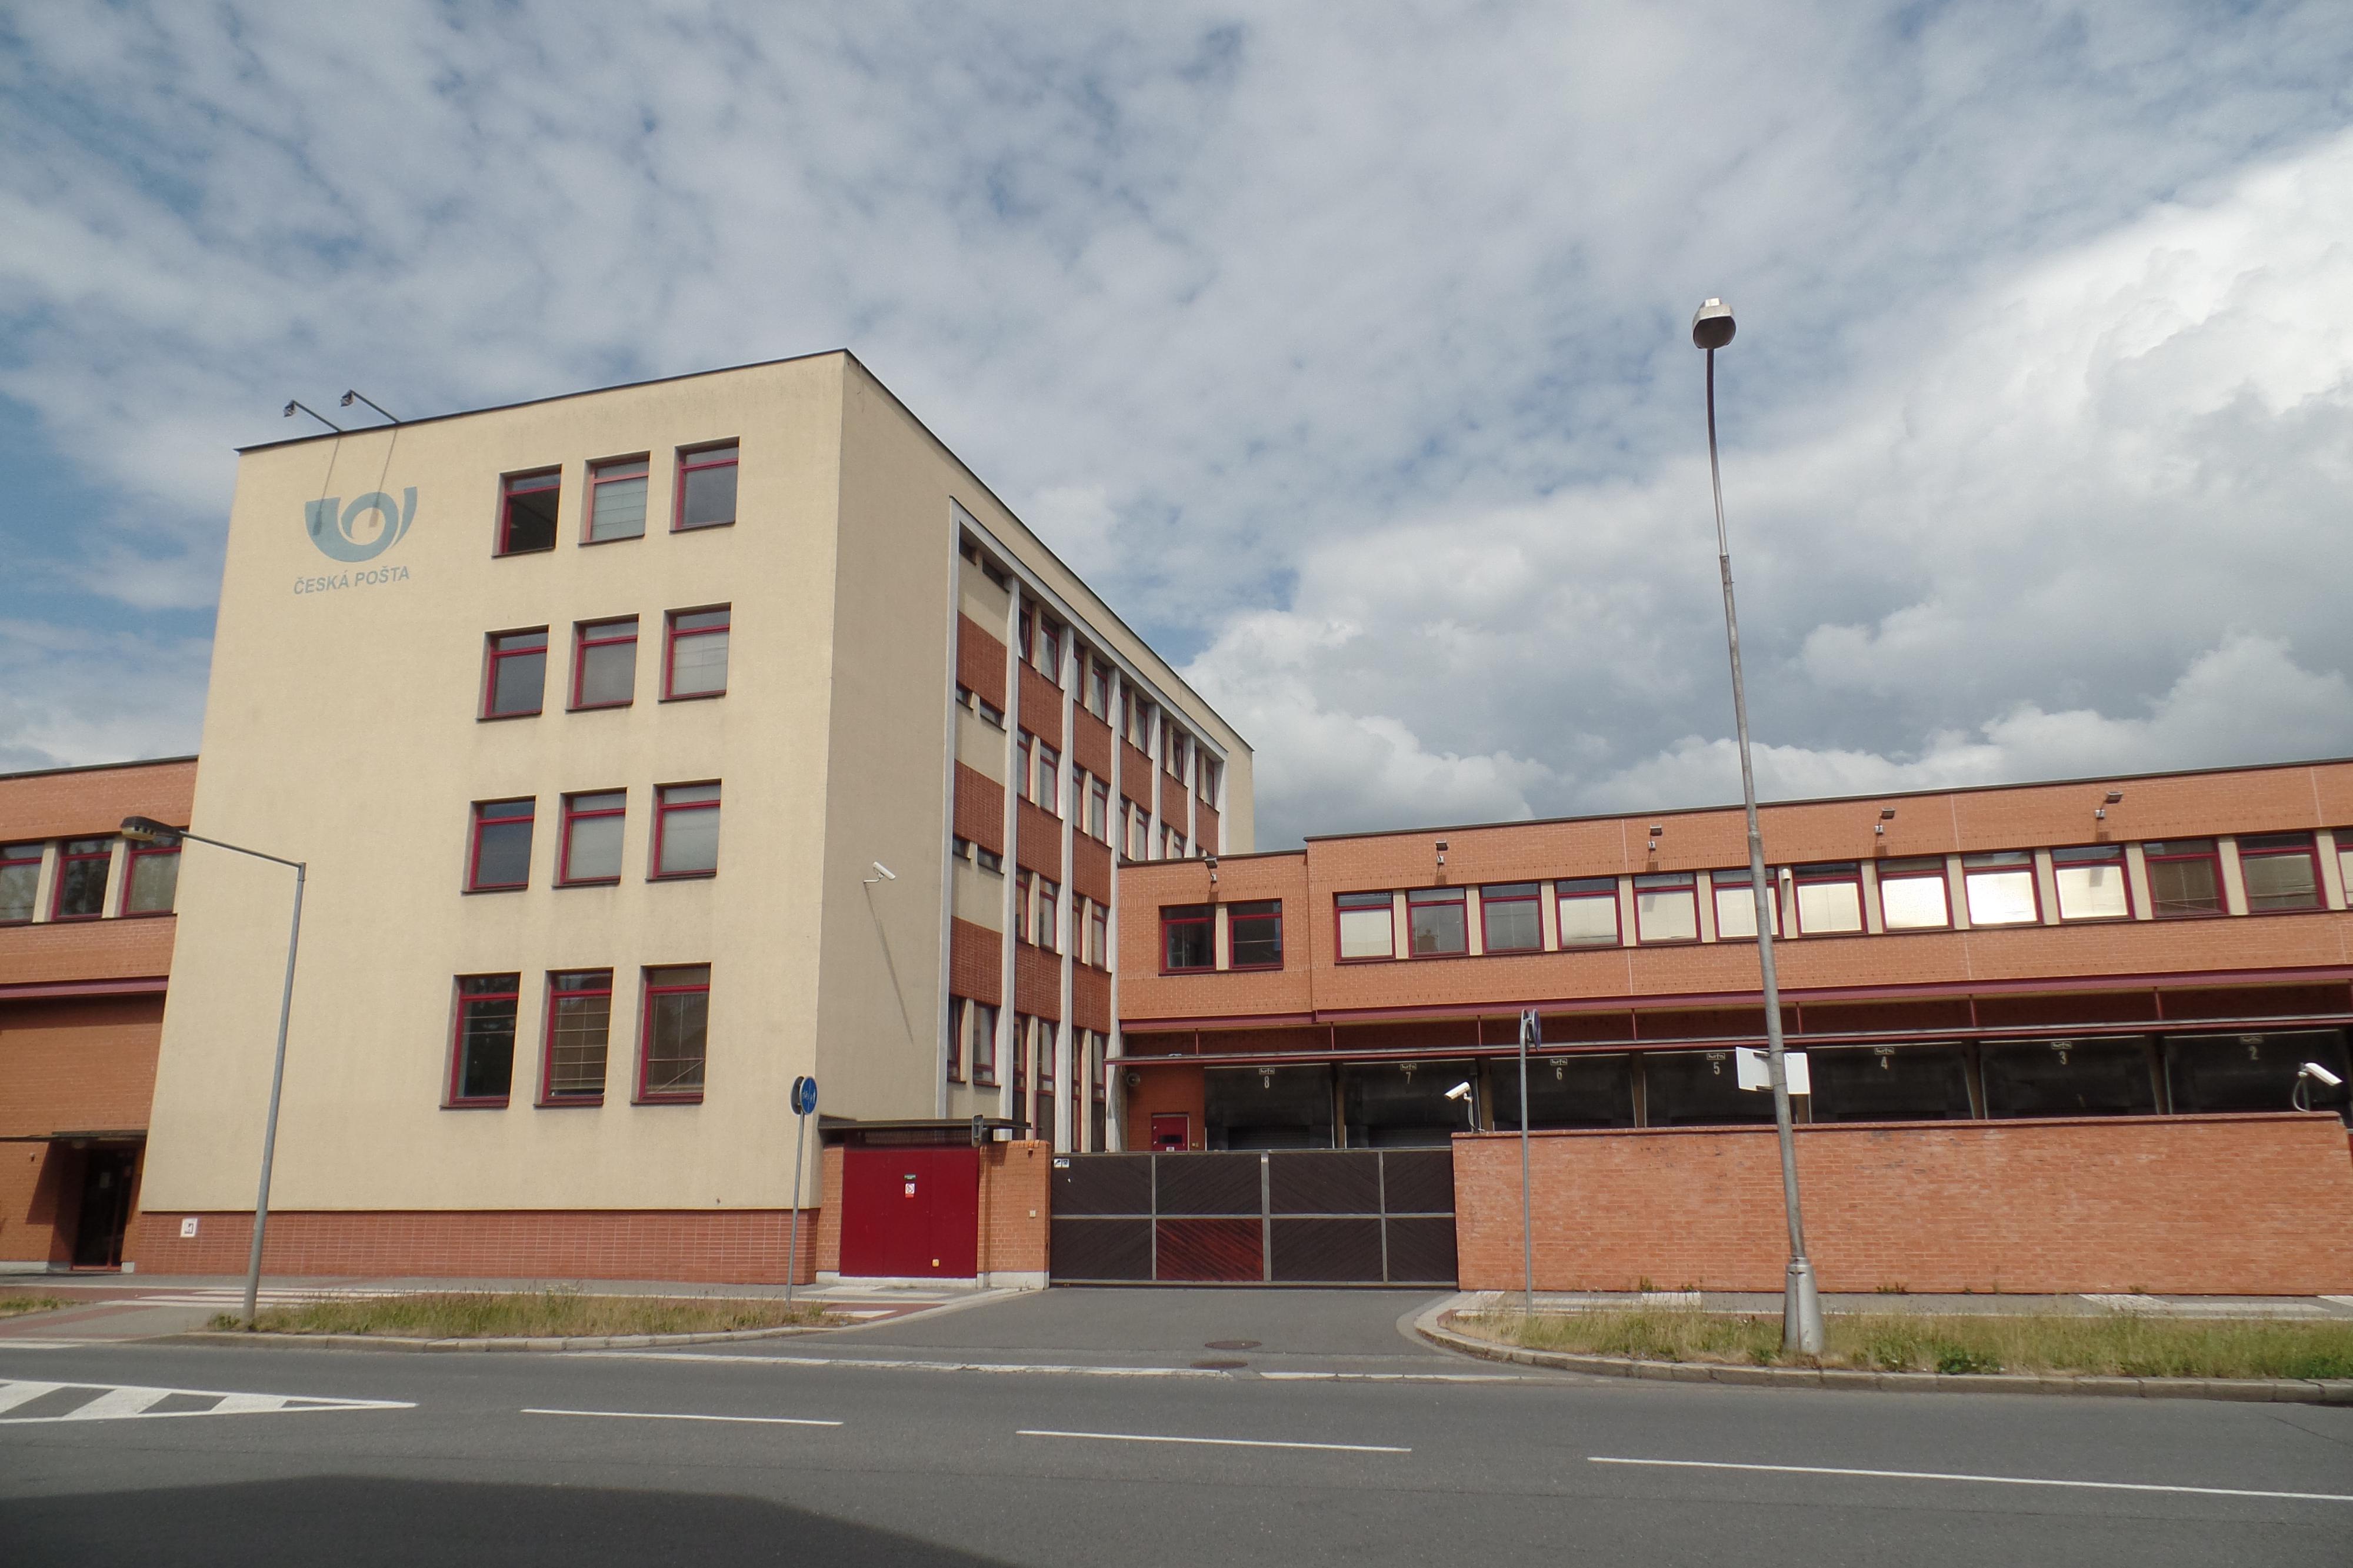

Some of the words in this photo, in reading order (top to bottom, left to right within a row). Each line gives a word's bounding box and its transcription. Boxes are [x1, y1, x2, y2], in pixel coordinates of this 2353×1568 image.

[294, 570, 349, 595] ČESKÁ
[354, 565, 409, 587] POŠTA
[2059, 1050, 2067, 1065] 3
[2248, 1045, 2258, 1060] 2
[1713, 1062, 1720, 1075] 5
[1881, 1056, 1888, 1069] 4
[1405, 1071, 1411, 1084] 7
[1557, 1067, 1562, 1080] 6
[1264, 1076, 1269, 1089] 8
